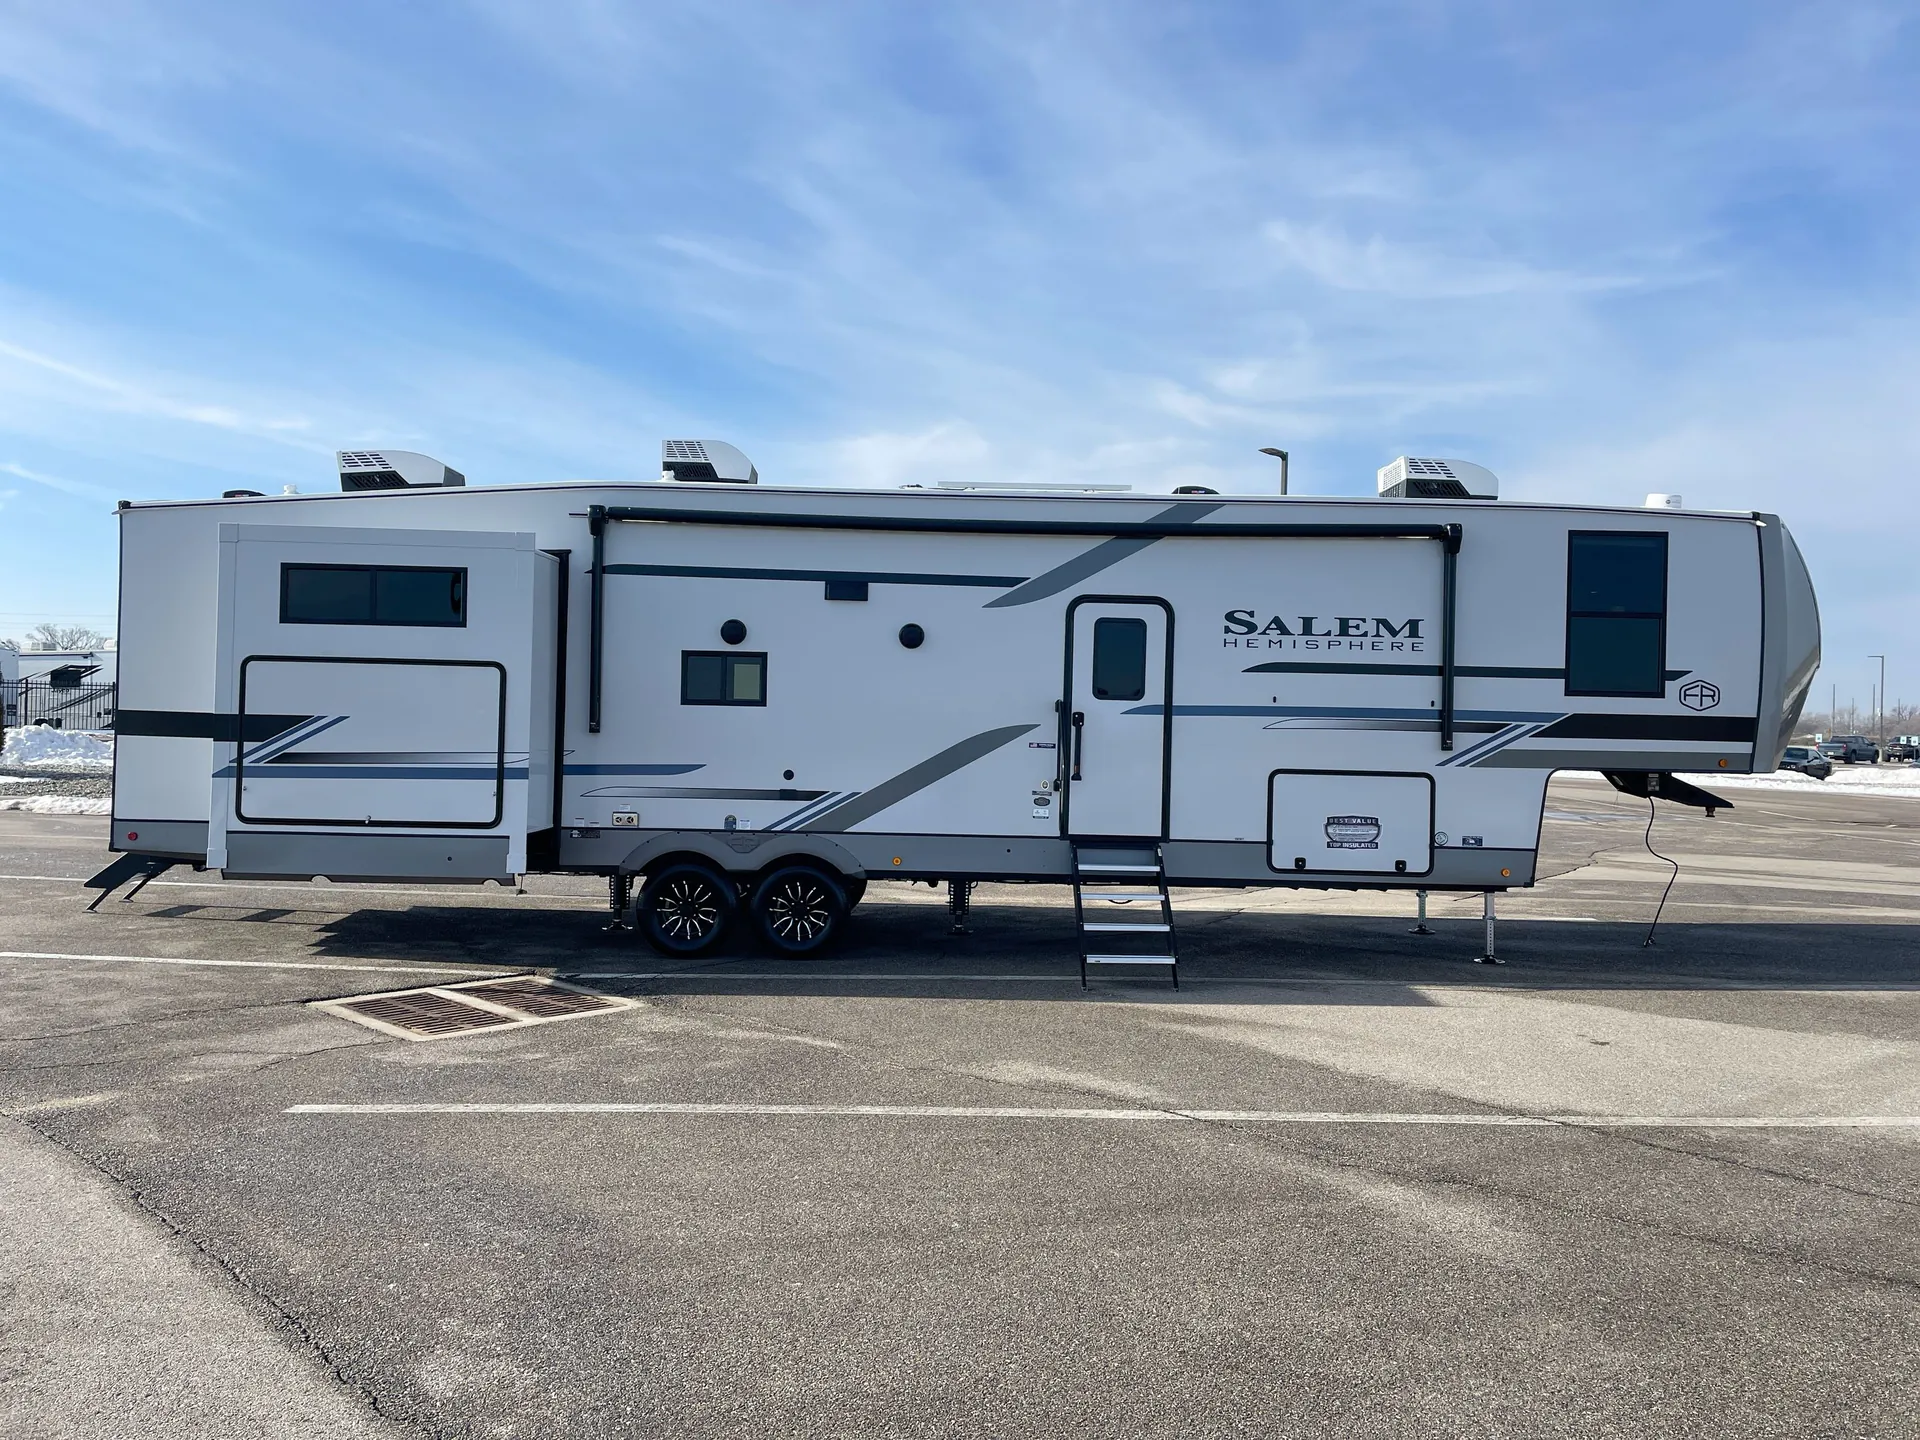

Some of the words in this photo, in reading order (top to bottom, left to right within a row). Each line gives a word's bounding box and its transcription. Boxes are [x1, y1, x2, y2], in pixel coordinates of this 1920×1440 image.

[1224, 609, 1425, 639] SALEM
[1223, 638, 1424, 652] HEMISPHERE
[1683, 684, 1716, 707] FR
